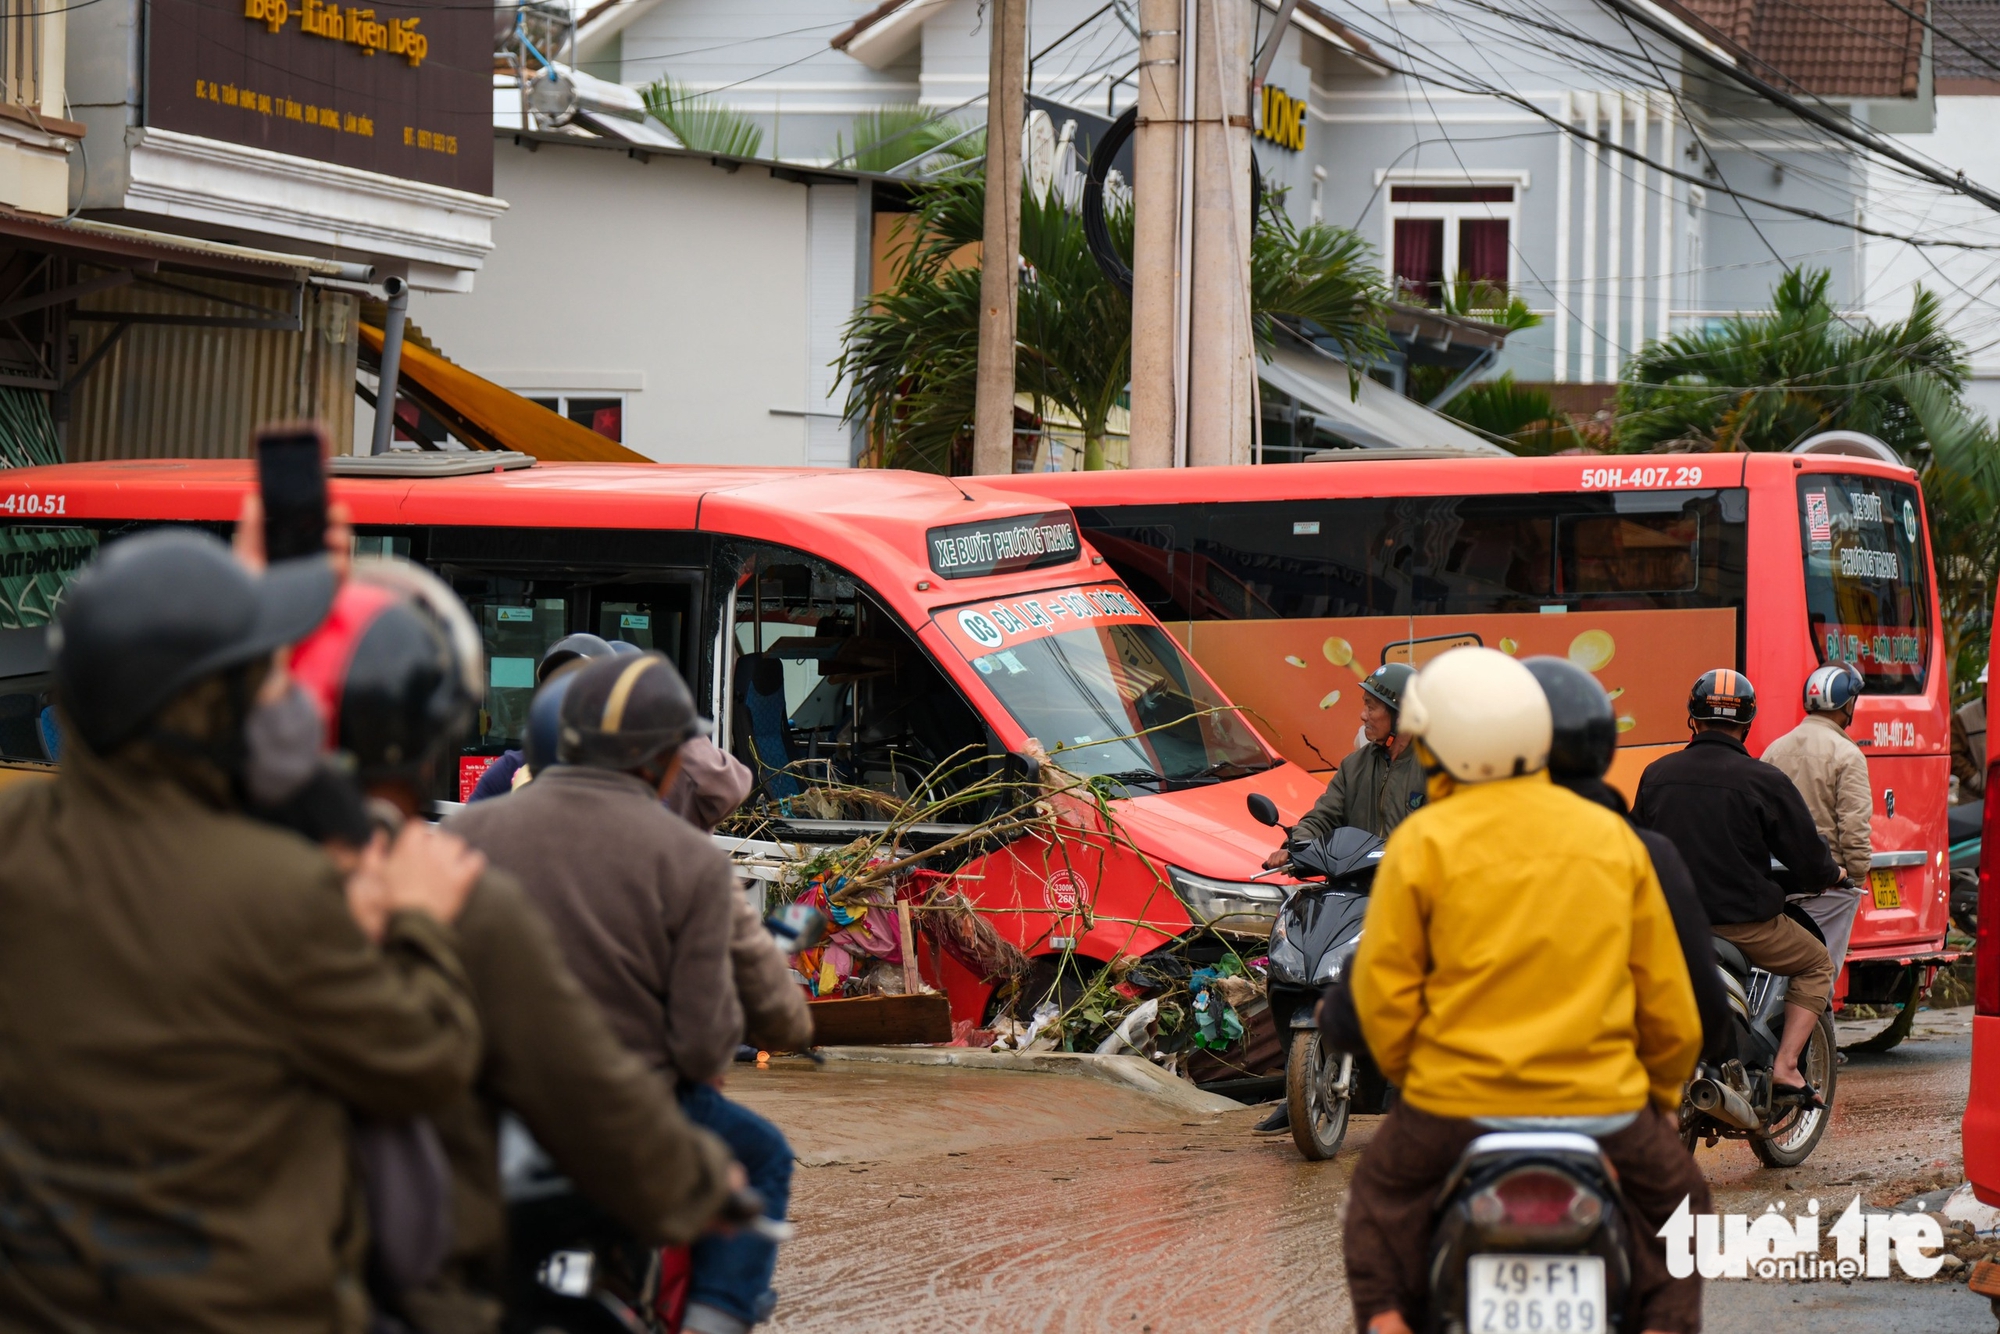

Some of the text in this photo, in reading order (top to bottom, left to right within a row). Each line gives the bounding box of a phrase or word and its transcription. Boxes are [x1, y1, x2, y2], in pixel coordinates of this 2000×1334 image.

[275, 97, 285, 116] TT
[1581, 466, 1702, 489] 50H-407.29
[1850, 492, 1863, 521] XE
[1863, 491, 1883, 522] BUÝT
[1904, 507, 1915, 534] 03
[935, 523, 1075, 568] XE BUÝT PHƯƠNG TRANG
[1841, 547, 1898, 579] PHƯƠNG TRANG
[964, 588, 1141, 643] 03 ĐÀ LẠT ĐƠN DƯƠNG
[1826, 628, 1919, 665] ĐÀ LẠT ĐƠN DƯƠNG
[1873, 722, 1914, 747] 50H-407.29
[1494, 1262, 1579, 1295] 49-F1
